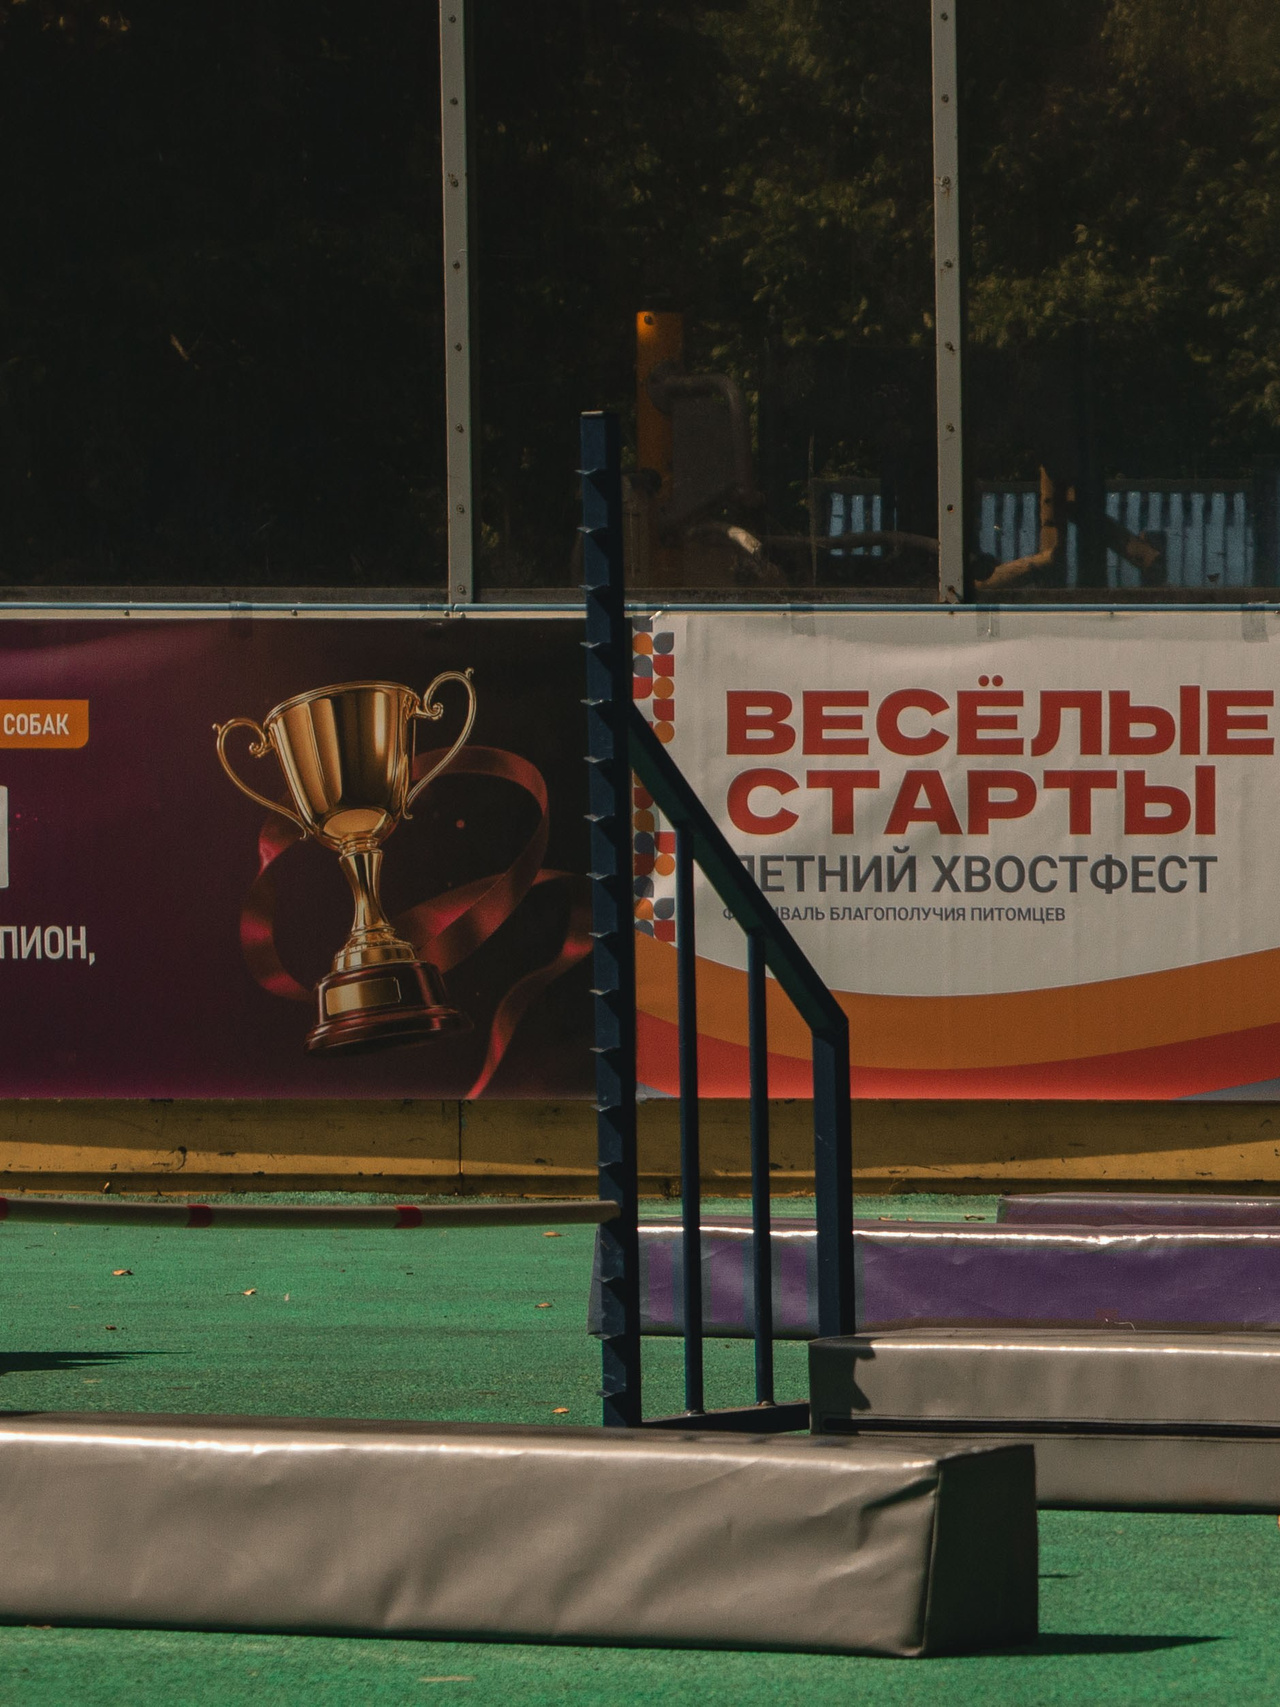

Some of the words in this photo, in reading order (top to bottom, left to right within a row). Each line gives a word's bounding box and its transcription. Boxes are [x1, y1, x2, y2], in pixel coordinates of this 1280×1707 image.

[3, 713, 70, 736] СОБАК
[726, 675, 1274, 757] ВЕСЁЛЫЕ
[726, 765, 1217, 836] СТАРТЫ
[931, 854, 1218, 894] ХВОСТФЕСТ
[829, 906, 966, 921] БЛАГОПОЛУЧИЯ
[971, 907, 1066, 924] ПИТОМЦЕВ
